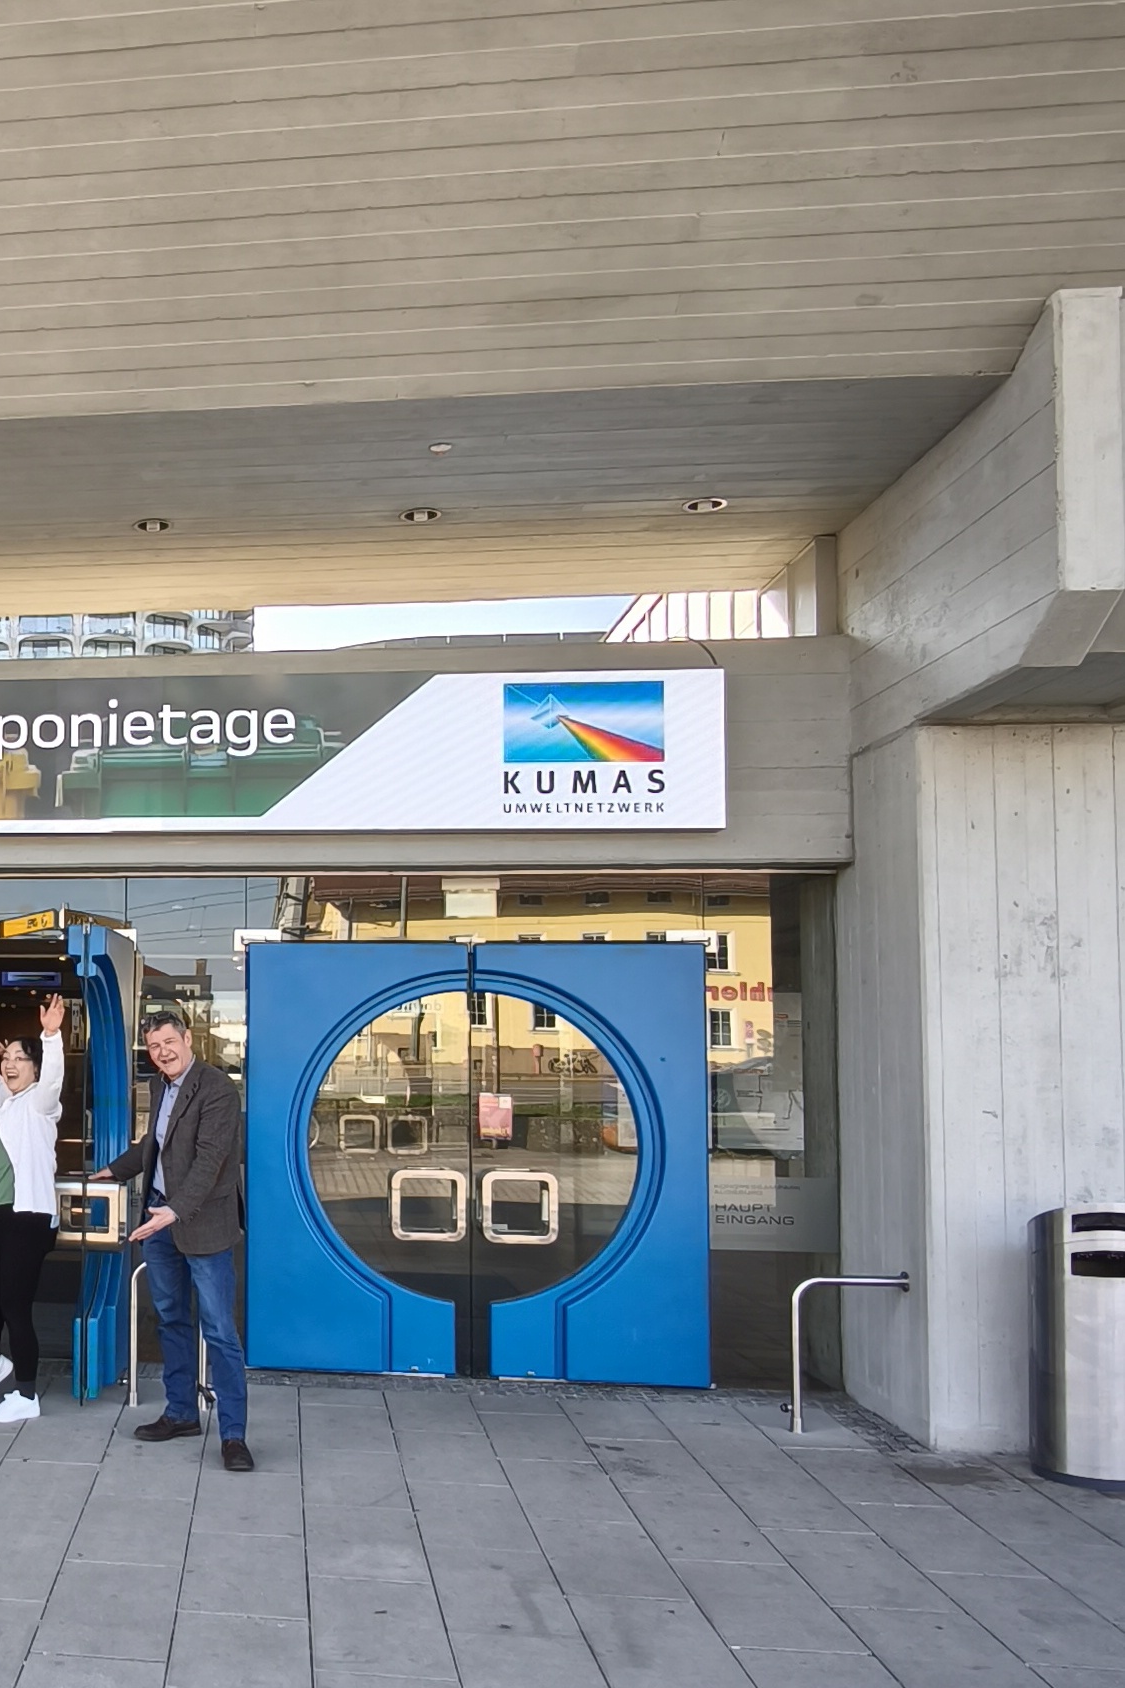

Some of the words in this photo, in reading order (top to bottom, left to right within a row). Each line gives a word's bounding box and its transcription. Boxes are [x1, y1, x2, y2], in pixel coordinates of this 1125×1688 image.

[503, 769, 665, 795] KUMAS
[503, 802, 664, 814] UMWELTNETZWERK
[715, 1203, 772, 1212] HAUPT
[715, 1214, 795, 1226] EINGANG
